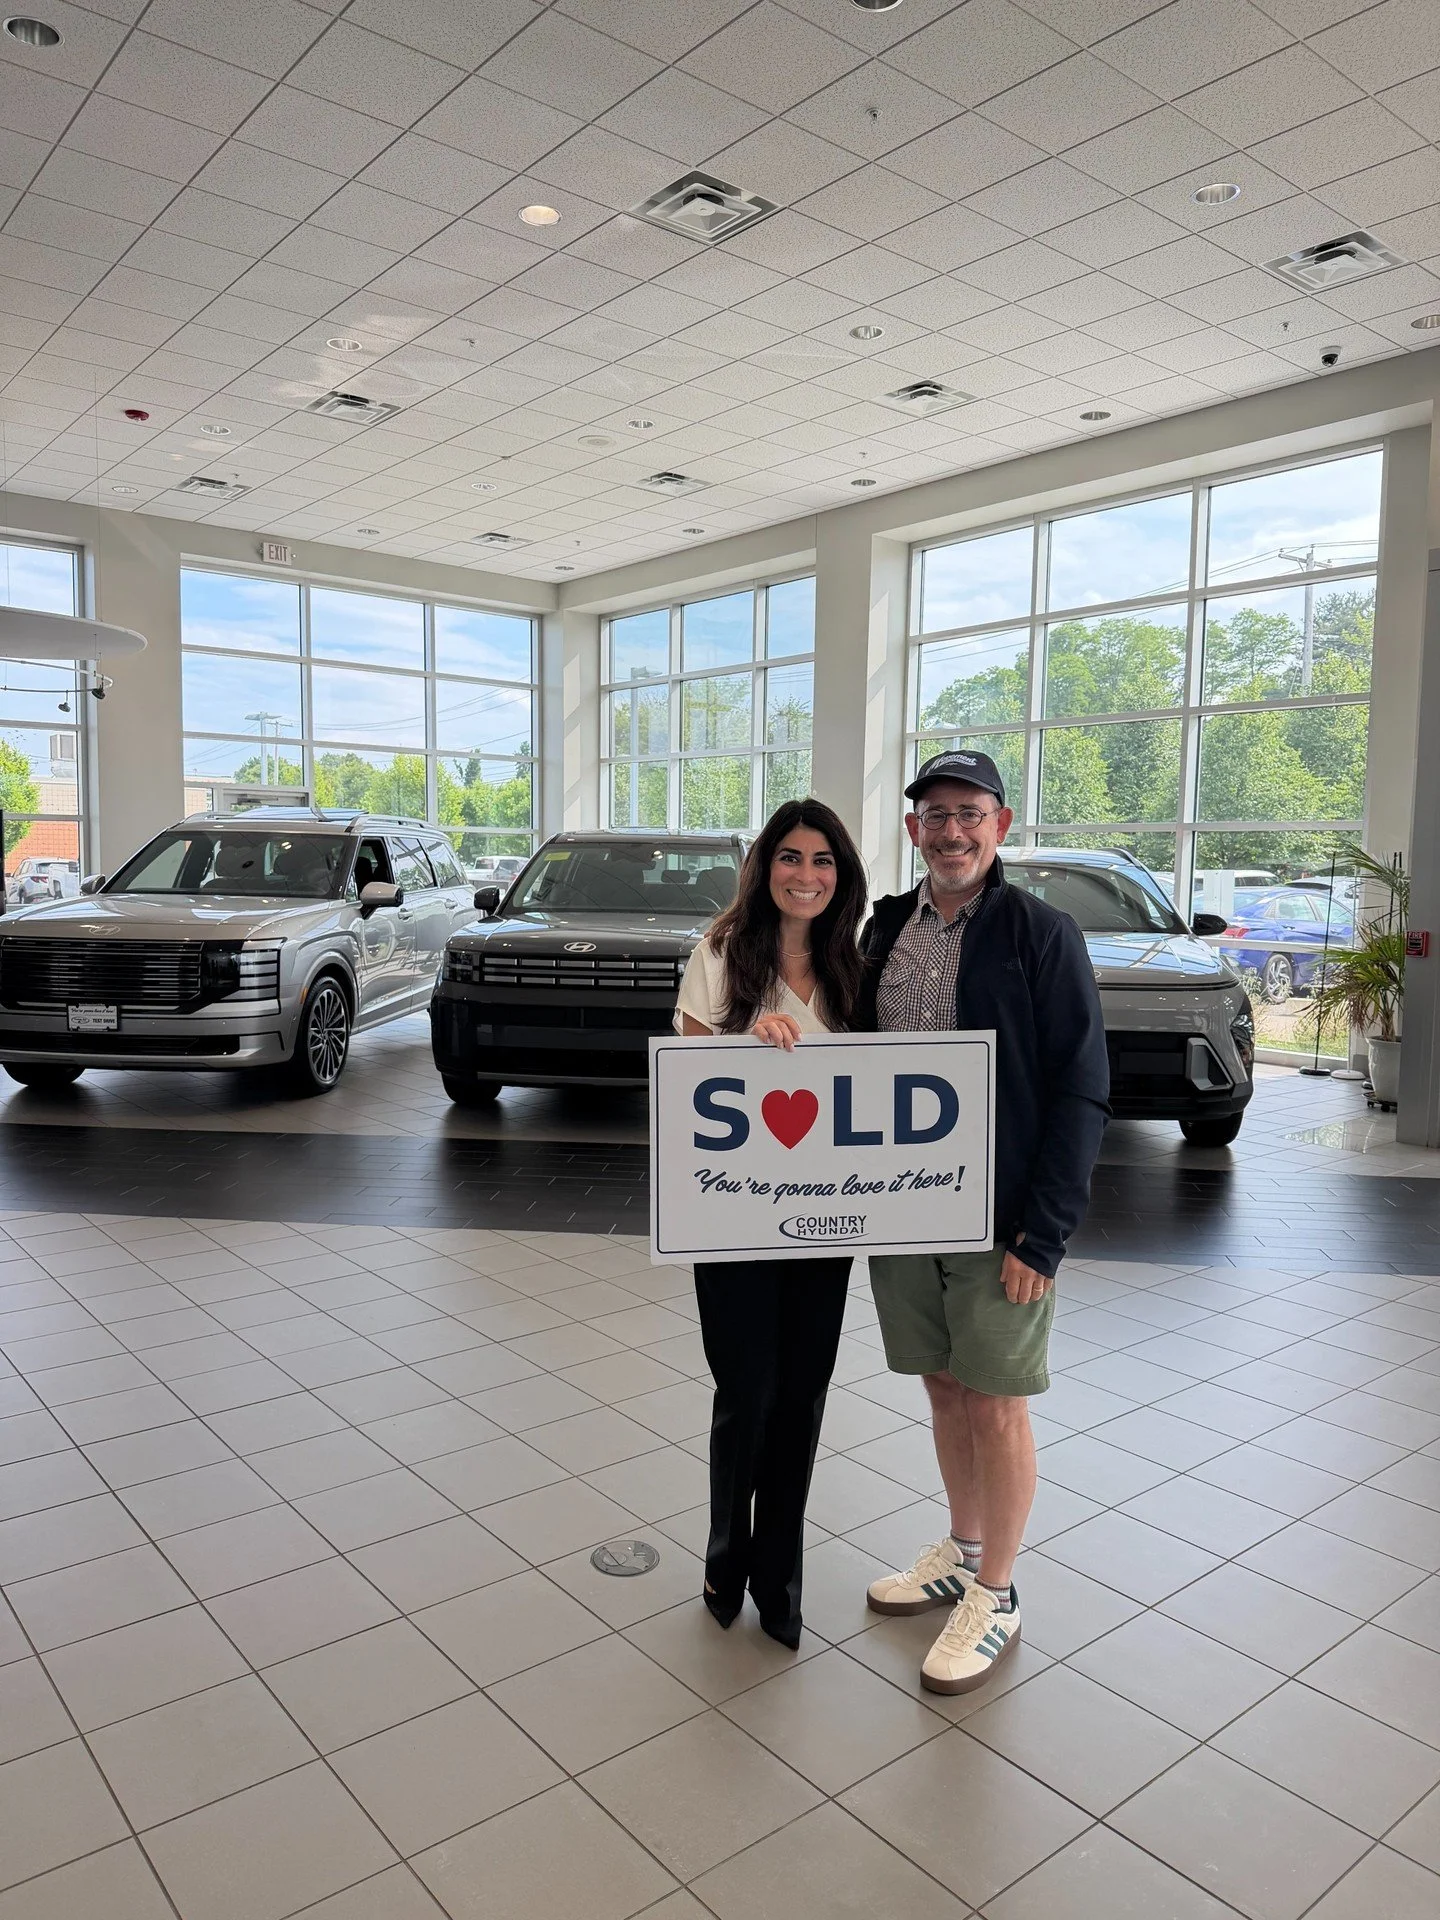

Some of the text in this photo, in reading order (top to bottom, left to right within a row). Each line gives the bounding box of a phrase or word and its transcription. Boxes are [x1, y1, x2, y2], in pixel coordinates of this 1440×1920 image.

[268, 544, 287, 561] EXIT
[694, 1165, 966, 1204] You're gonna love it here!
[796, 1215, 867, 1228] COUNTRY
[797, 1226, 864, 1236] HYUNDAI
